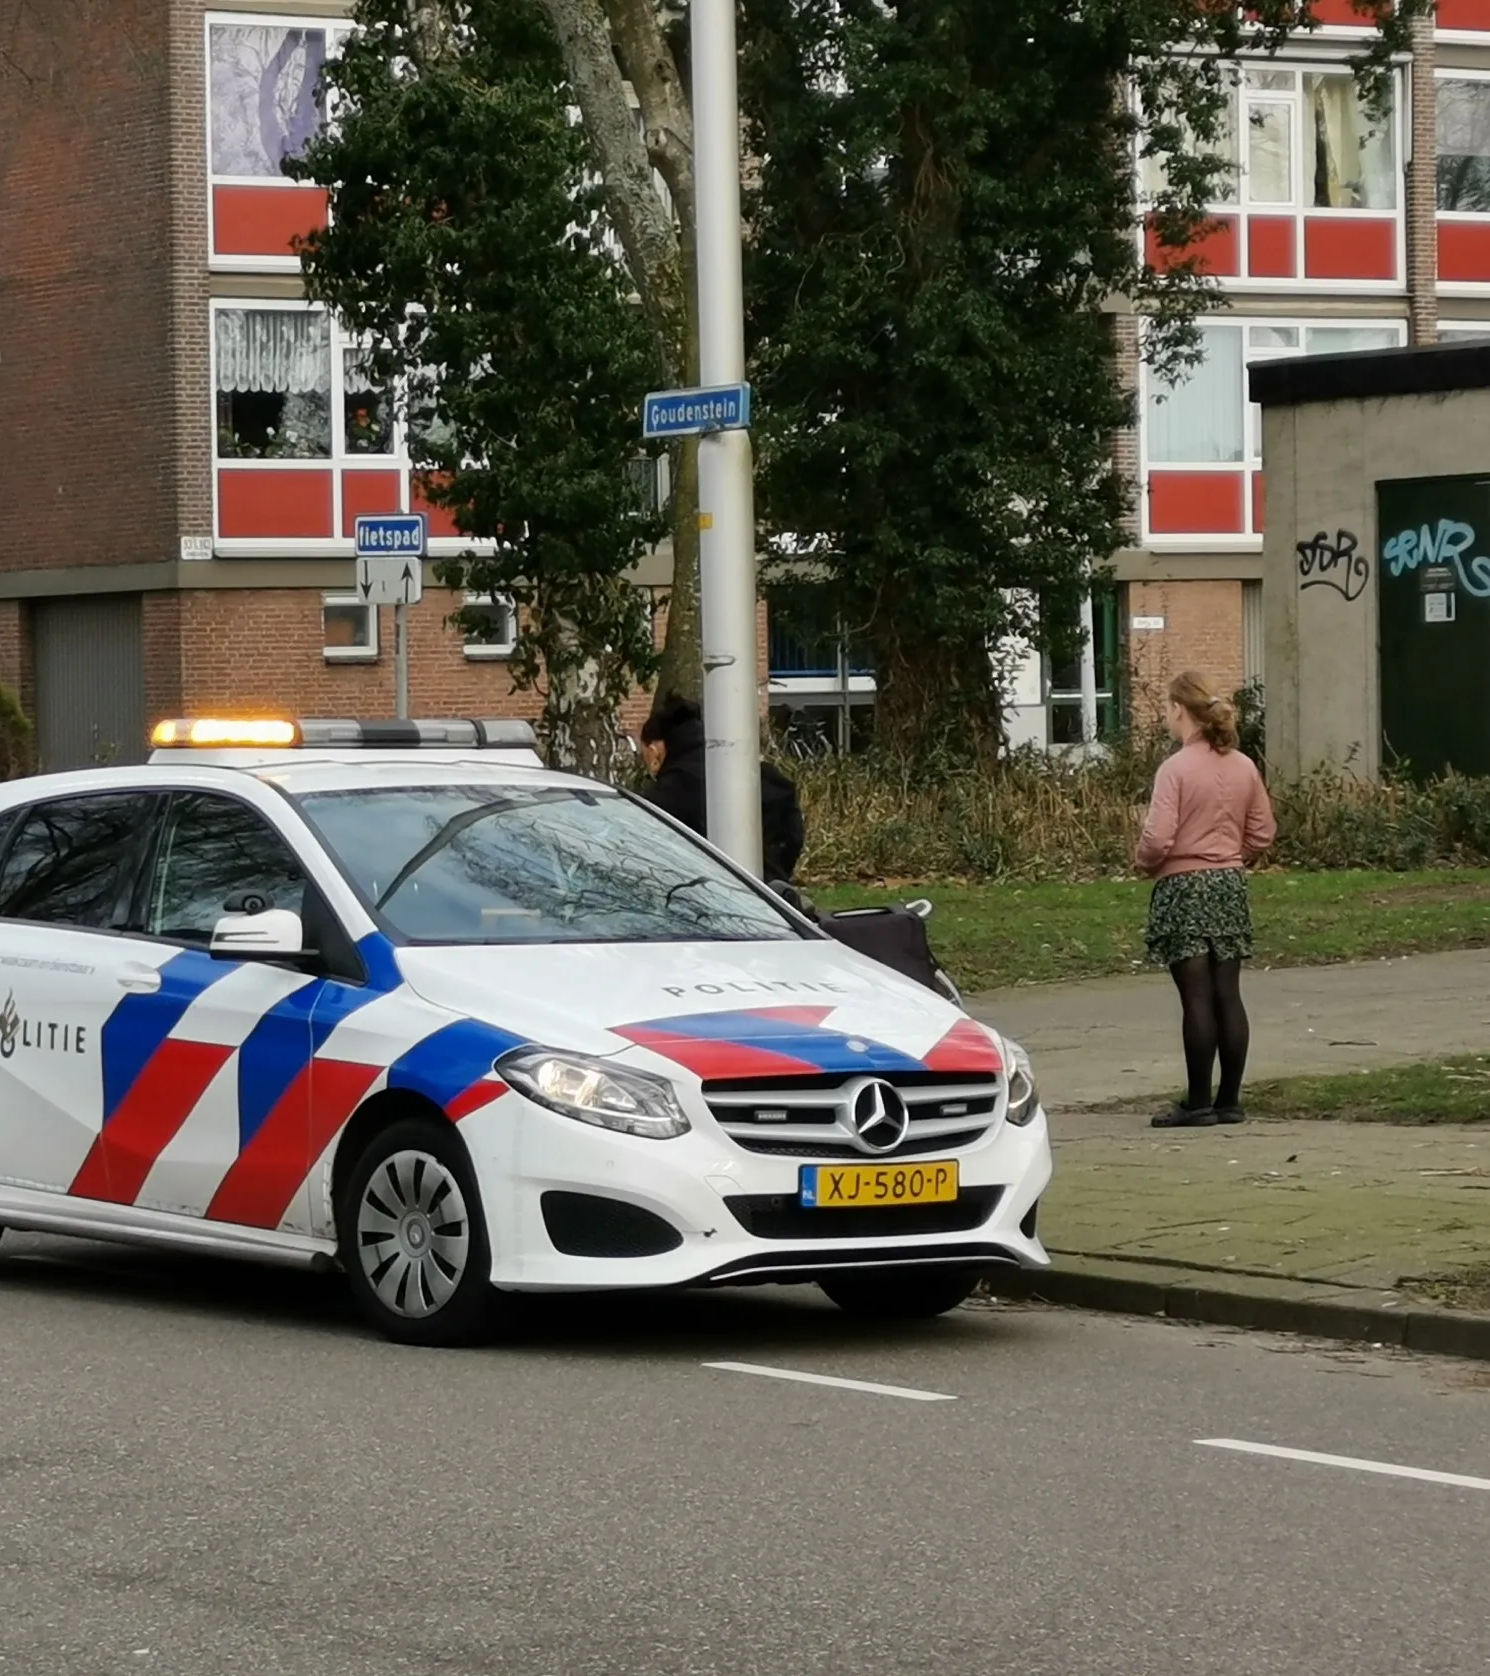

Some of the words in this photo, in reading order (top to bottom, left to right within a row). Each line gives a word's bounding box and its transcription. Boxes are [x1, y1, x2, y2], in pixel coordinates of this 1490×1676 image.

[651, 398, 736, 425] Goudenstein
[359, 525, 420, 549] fietspad
[662, 981, 848, 998] POLITIE
[828, 1168, 947, 1201] XJ-580-P
